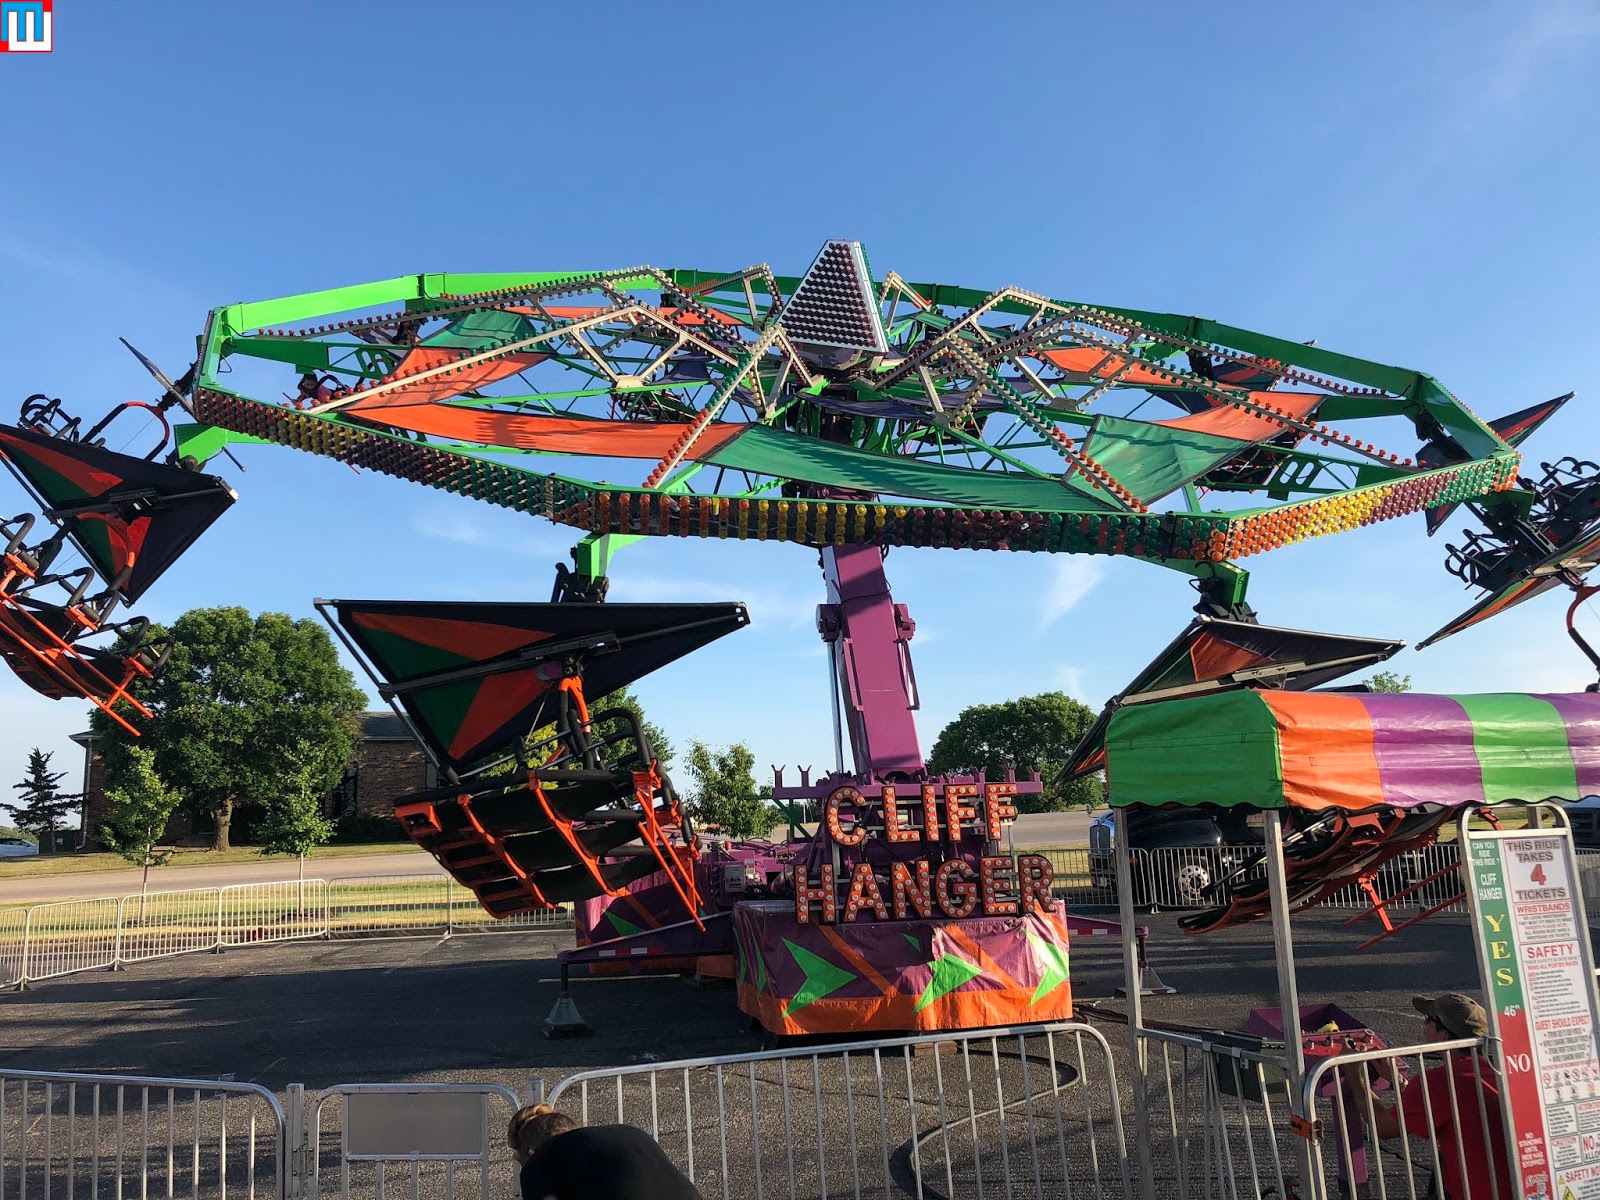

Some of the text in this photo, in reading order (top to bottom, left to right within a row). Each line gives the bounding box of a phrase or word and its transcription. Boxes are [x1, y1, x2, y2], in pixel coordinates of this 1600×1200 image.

[825, 783, 1018, 846] CLIFF
[1472, 841, 1495, 850] CAN YOU
[1506, 840, 1560, 852] THIS RIDE
[1478, 850, 1491, 858] RIDE
[1515, 851, 1554, 863] TAKES
[1485, 858, 1496, 866] RIDE
[1480, 873, 1497, 886] CLIFF
[1530, 864, 1547, 885] 4
[794, 854, 1055, 925] HANGER
[1478, 888, 1503, 901] HANGER
[1515, 888, 1567, 900] TICKETS
[1517, 902, 1571, 914] WRISTBANDS
[1484, 914, 1514, 987] YES
[1527, 943, 1573, 959] SAFETY
[1535, 1019, 1550, 1030] GUEST
[1551, 1017, 1570, 1028] SHOULD
[1506, 1053, 1531, 1074] NO
[1552, 1137, 1576, 1147] CAUTION
[1582, 1135, 1594, 1151] NO
[1565, 1168, 1590, 1183] SAFETY
